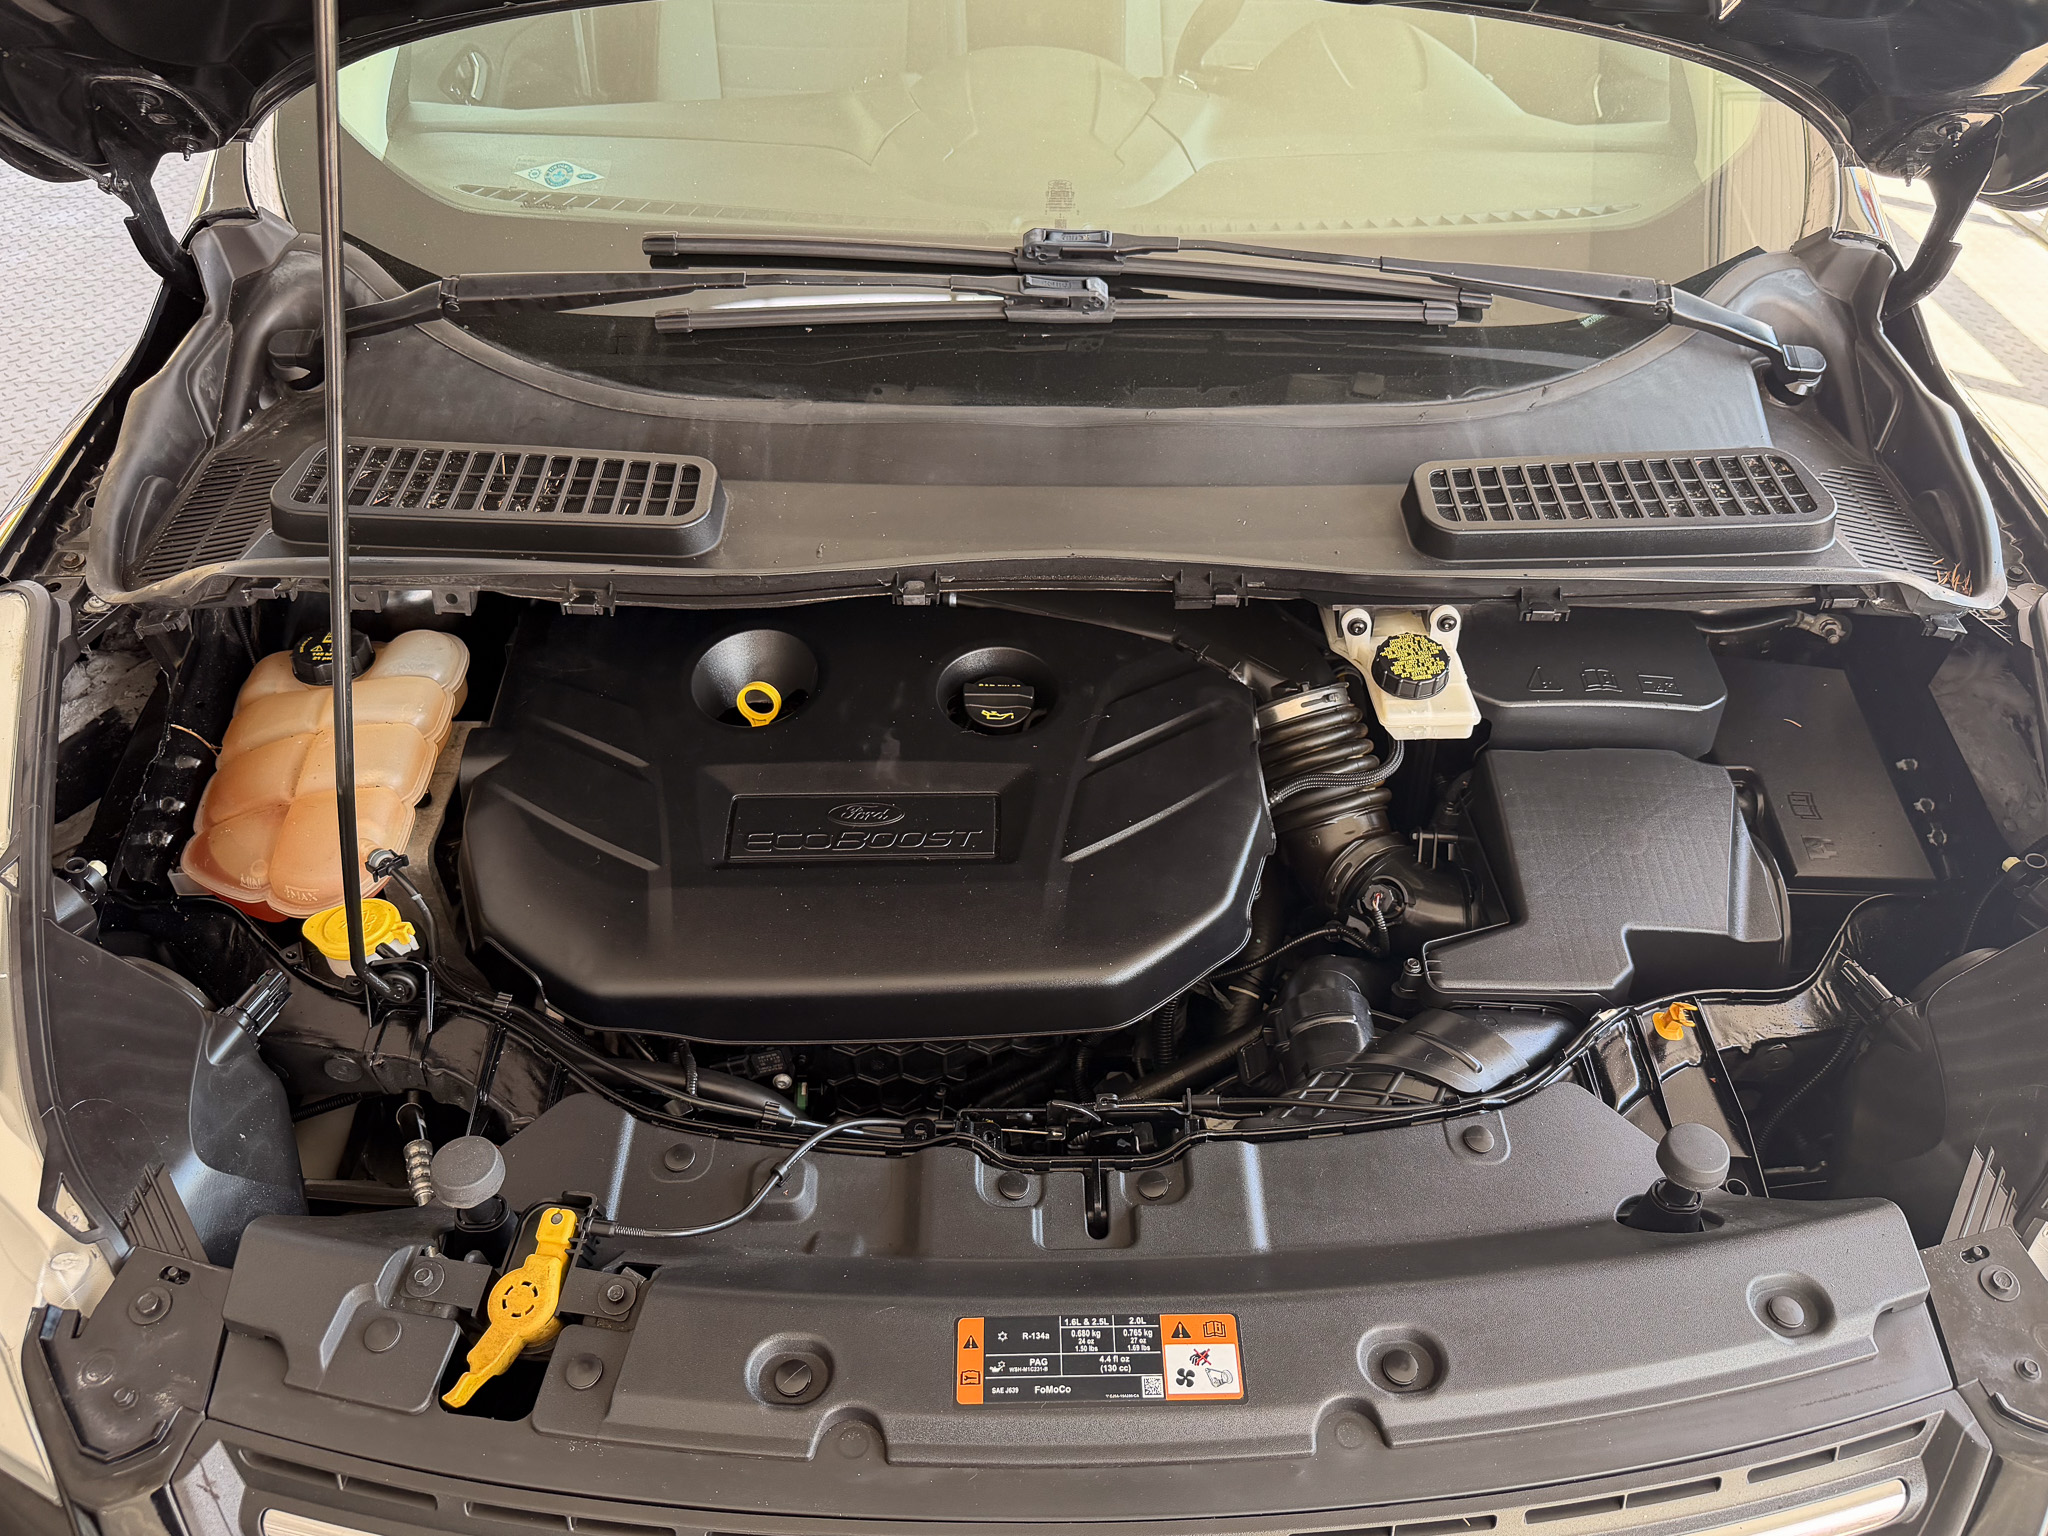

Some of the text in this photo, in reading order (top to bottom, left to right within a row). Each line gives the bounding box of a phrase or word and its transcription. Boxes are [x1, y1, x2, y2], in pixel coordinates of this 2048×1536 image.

[840, 805, 889, 822] Ford
[744, 829, 983, 852] ECOBOOST
[240, 874, 261, 888] MIN
[289, 889, 318, 902] MAX
[1064, 1317, 1110, 1326] 1.6L & 2.5L
[1129, 1316, 1147, 1325] 2.0L
[1022, 1331, 1050, 1340] R-134a
[1070, 1329, 1101, 1339] 0.680 kg
[1122, 1328, 1153, 1338] 0.765 kg
[1029, 1357, 1049, 1366] PAG
[1098, 1355, 1112, 1363] 4.4
[1113, 1355, 1119, 1363] fl
[1100, 1364, 1132, 1374] (130 cc)
[991, 1386, 1020, 1395] SAE J639
[1034, 1385, 1072, 1394] FoMoCo
